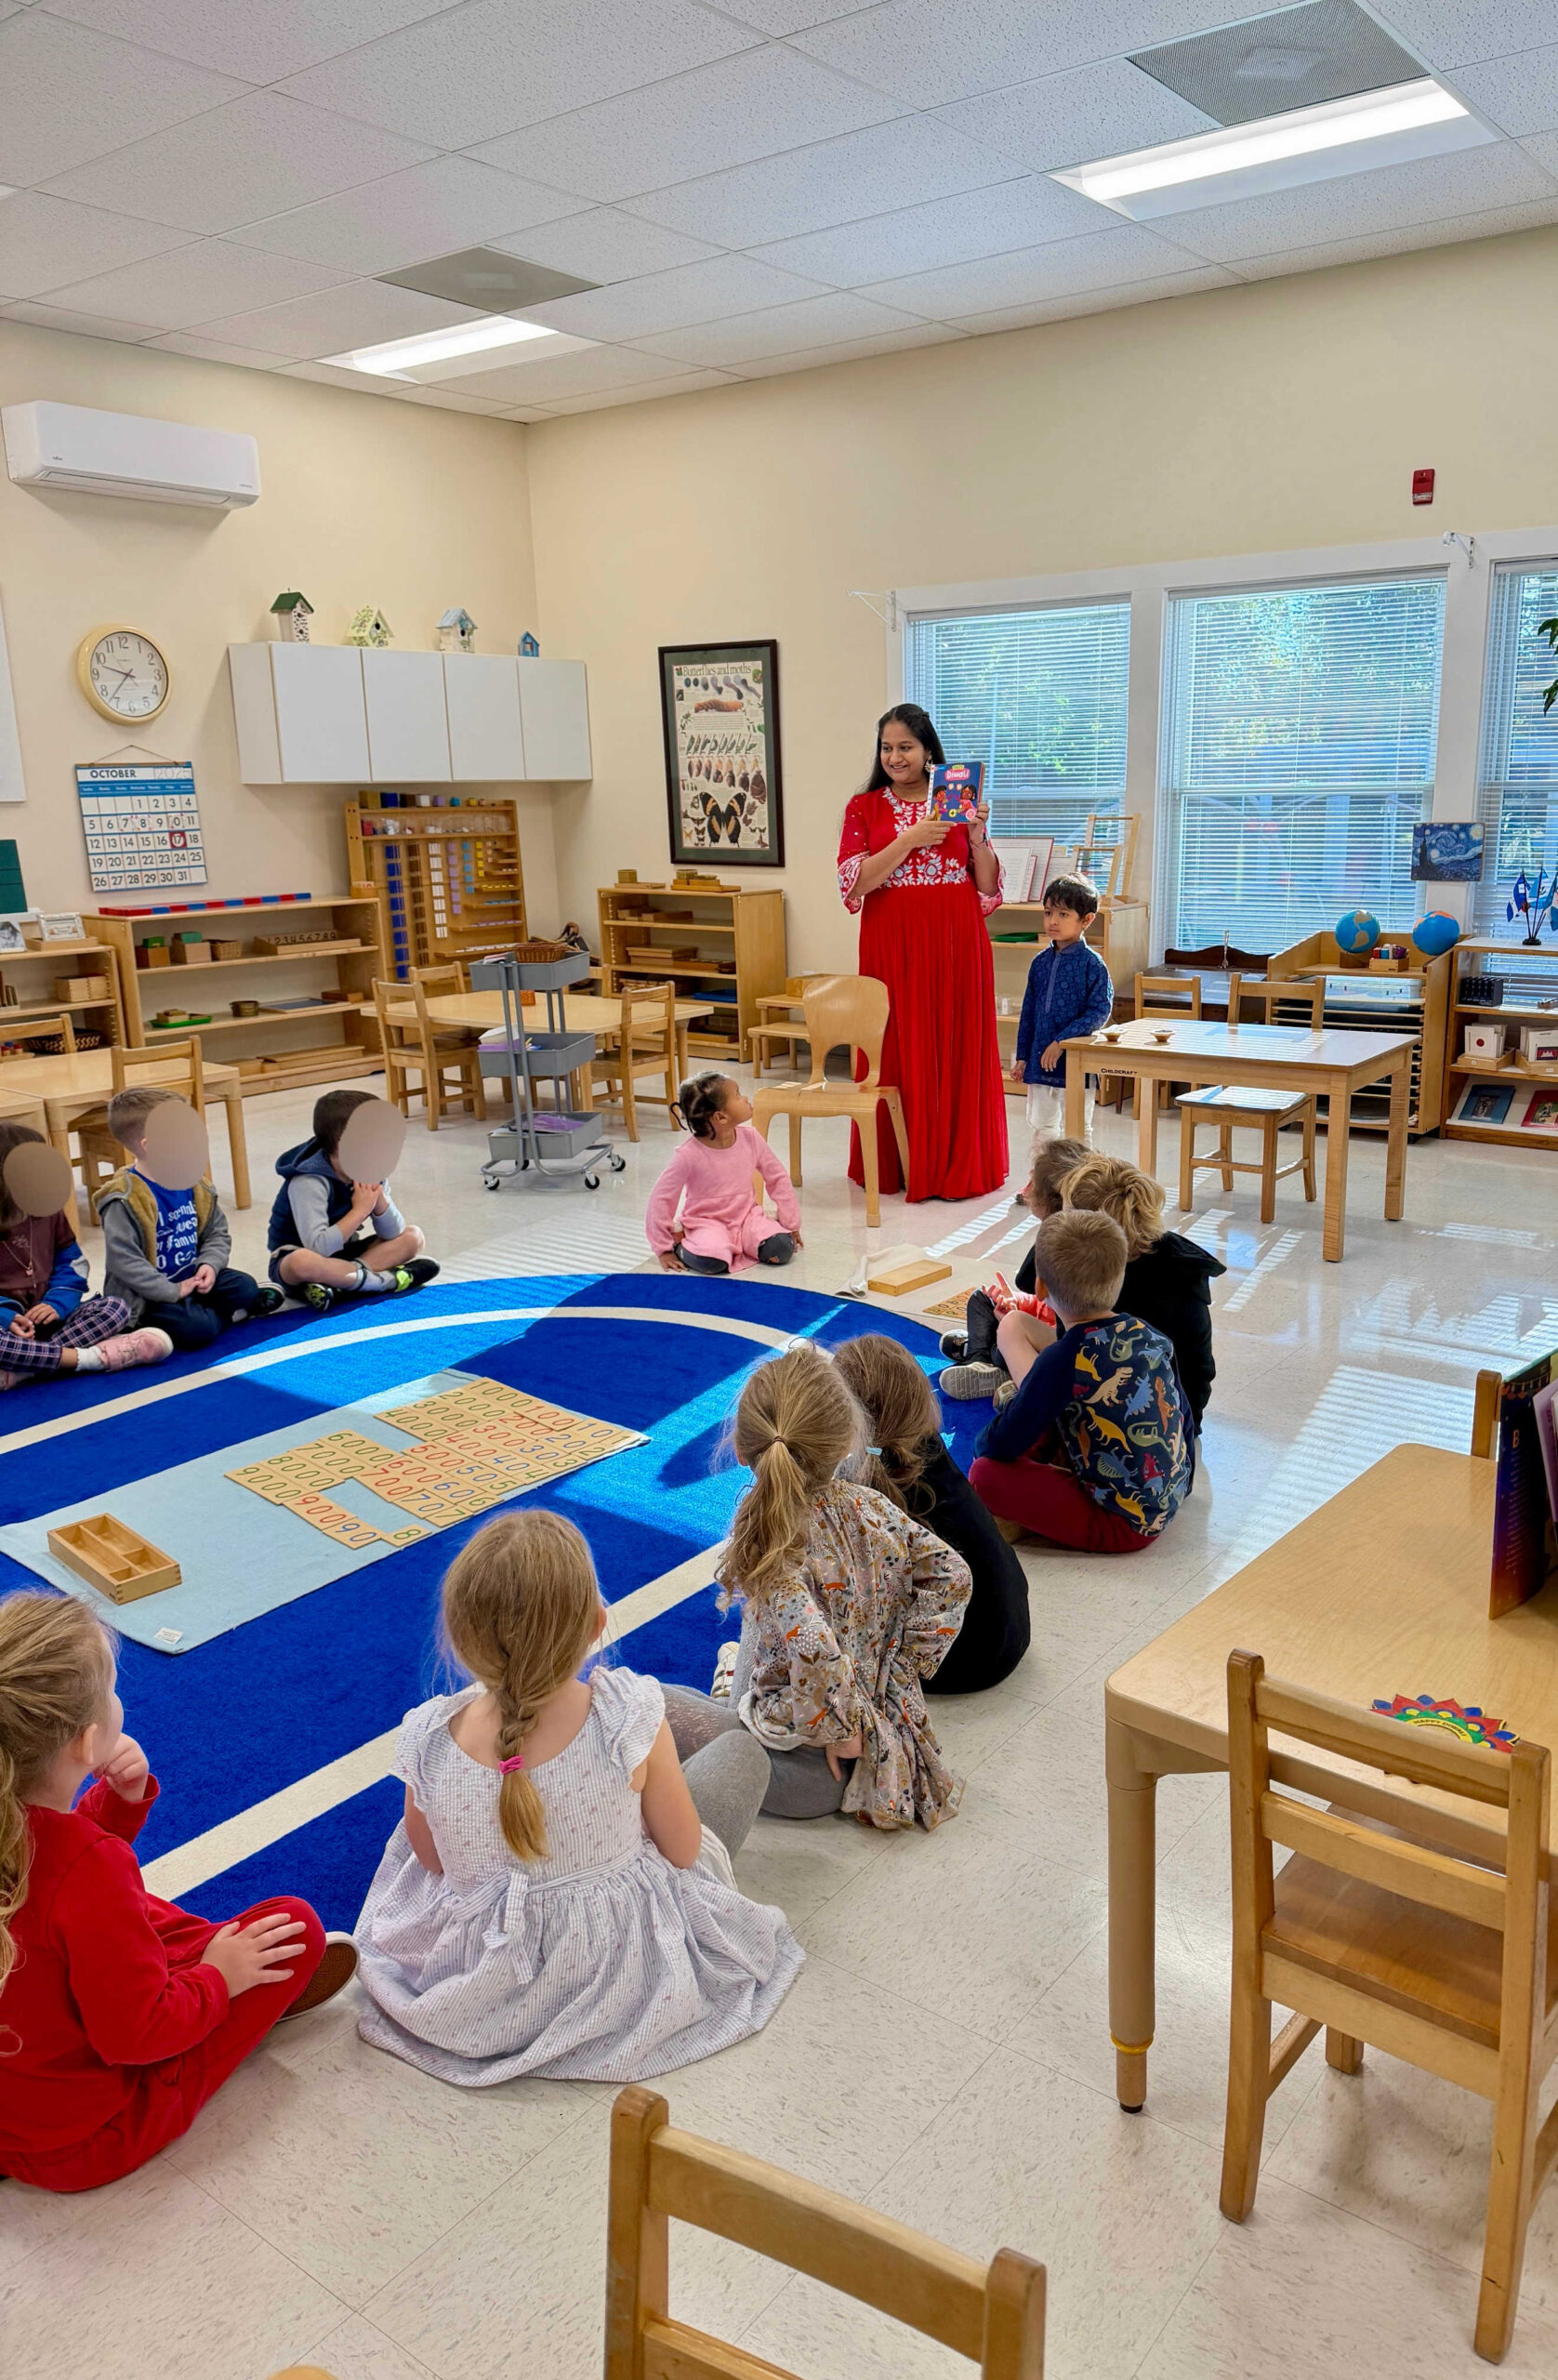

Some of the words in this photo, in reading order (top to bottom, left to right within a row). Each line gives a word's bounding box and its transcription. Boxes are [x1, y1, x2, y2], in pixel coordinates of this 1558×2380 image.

[106, 641, 114, 654] 11
[117, 636, 129, 649] 12
[138, 641, 142, 654] 1
[95, 652, 106, 665] 10
[147, 654, 155, 666] 2
[92, 668, 99, 681] 9
[154, 669, 162, 681] 3
[717, 663, 729, 675] and
[730, 662, 751, 674] moths
[100, 684, 109, 697] 8
[152, 684, 159, 696] 4
[114, 696, 120, 708] 7
[128, 701, 136, 713] 6
[142, 696, 151, 708] 5
[90, 770, 137, 778] OCTOBER
[138, 800, 142, 808] 1
[154, 800, 160, 808] 2
[170, 799, 176, 807] 3
[186, 798, 191, 806] 4
[89, 820, 95, 829] 5
[107, 819, 113, 829] 6
[123, 818, 128, 827] 7
[140, 818, 147, 828] 8
[156, 818, 163, 827] 9
[187, 816, 194, 826] 11
[89, 840, 100, 849] 12
[107, 839, 117, 848] 13
[124, 838, 134, 847] 14
[141, 837, 151, 846] 15
[157, 837, 167, 845] 16
[174, 836, 182, 844] 17
[189, 834, 199, 843] 18
[93, 858, 103, 867] 19
[110, 857, 122, 866] 20
[126, 856, 137, 866] 21
[142, 855, 154, 865] 22
[159, 854, 170, 864] 23
[174, 853, 186, 863] 24
[191, 853, 202, 861] 25
[94, 878, 107, 887] 26
[112, 877, 123, 886] 27
[127, 875, 139, 884] 28
[144, 874, 156, 883] 29
[161, 873, 173, 882] 30
[178, 872, 187, 880] 31
[274, 936, 281, 945] 2
[284, 936, 289, 945] 3
[290, 935, 297, 944] 4
[298, 934, 305, 943] 5
[307, 933, 312, 942] 6
[314, 932, 321, 941] 7
[470, 1382, 533, 1408] 1000
[525, 1406, 574, 1426] 100
[576, 1422, 614, 1437] 10
[612, 1435, 631, 1445] 1
[439, 1391, 506, 1418] 2000
[498, 1415, 554, 1435] 200
[545, 1434, 586, 1448] 20
[578, 1447, 605, 1456] 2
[413, 1401, 479, 1428] 3000
[472, 1425, 526, 1447] 300
[520, 1445, 560, 1460] 30
[553, 1459, 577, 1468] 3
[385, 1408, 448, 1437] 4000
[446, 1434, 497, 1457] 400
[493, 1455, 530, 1471] 40
[525, 1469, 549, 1480] 4
[267, 1456, 336, 1488] 8000
[327, 1432, 394, 1462] 6000
[388, 1460, 442, 1483] 600
[433, 1481, 475, 1498] 60
[469, 1497, 495, 1506] 6
[410, 1444, 465, 1467] 500
[456, 1465, 498, 1482] 50
[489, 1480, 518, 1490] 5
[297, 1443, 365, 1474] 7000
[361, 1468, 414, 1496] 700
[402, 1493, 444, 1512] 70
[436, 1508, 466, 1518] 7
[236, 1466, 302, 1500] 9000
[295, 1496, 347, 1525] 900
[335, 1522, 377, 1542] 90
[393, 1528, 422, 1540] 8
